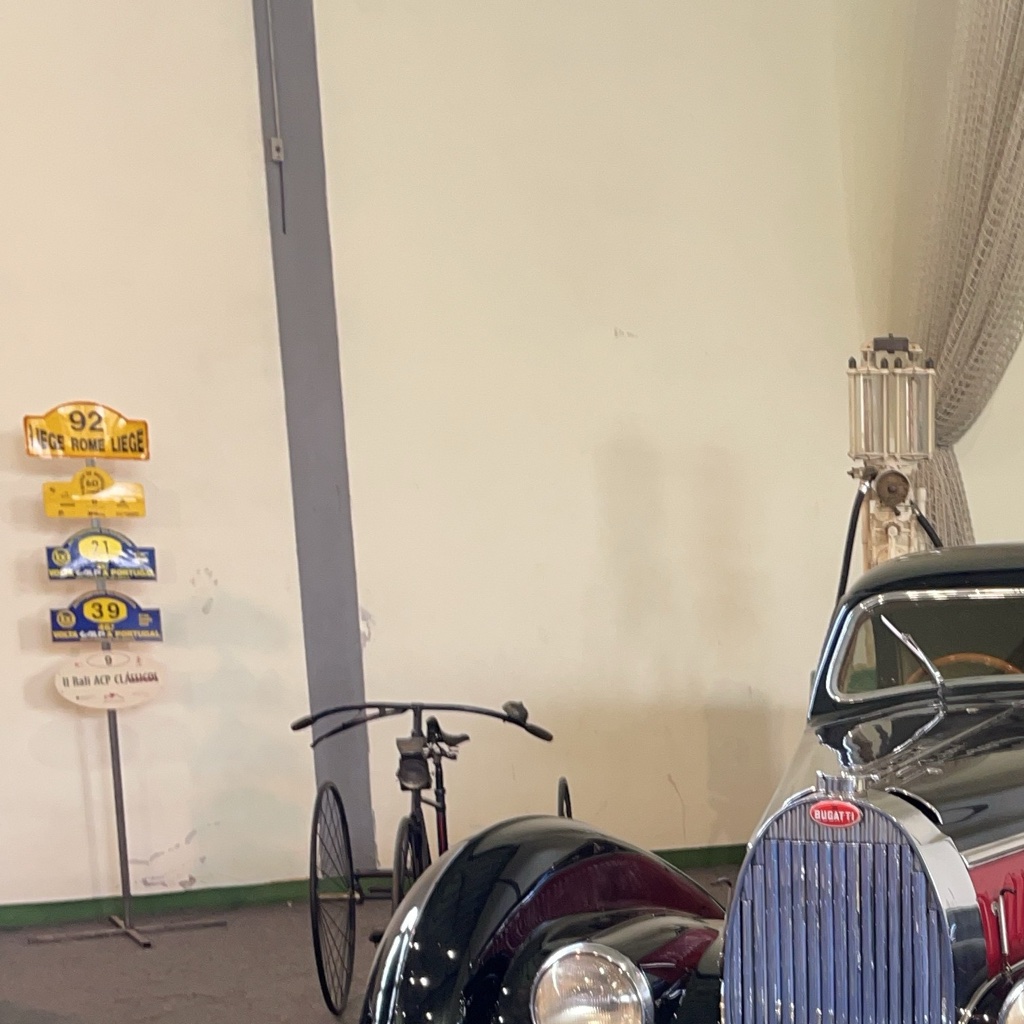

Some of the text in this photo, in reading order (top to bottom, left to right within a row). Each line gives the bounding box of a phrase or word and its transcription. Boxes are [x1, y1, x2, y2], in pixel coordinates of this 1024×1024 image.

[69, 409, 104, 433] 92
[71, 436, 106, 452] ROME
[111, 428, 145, 453] LIEGE
[91, 601, 120, 620] 39
[115, 630, 160, 639] PORTUGAL
[93, 675, 111, 686] ACP
[814, 810, 854, 822] BUGATTI
